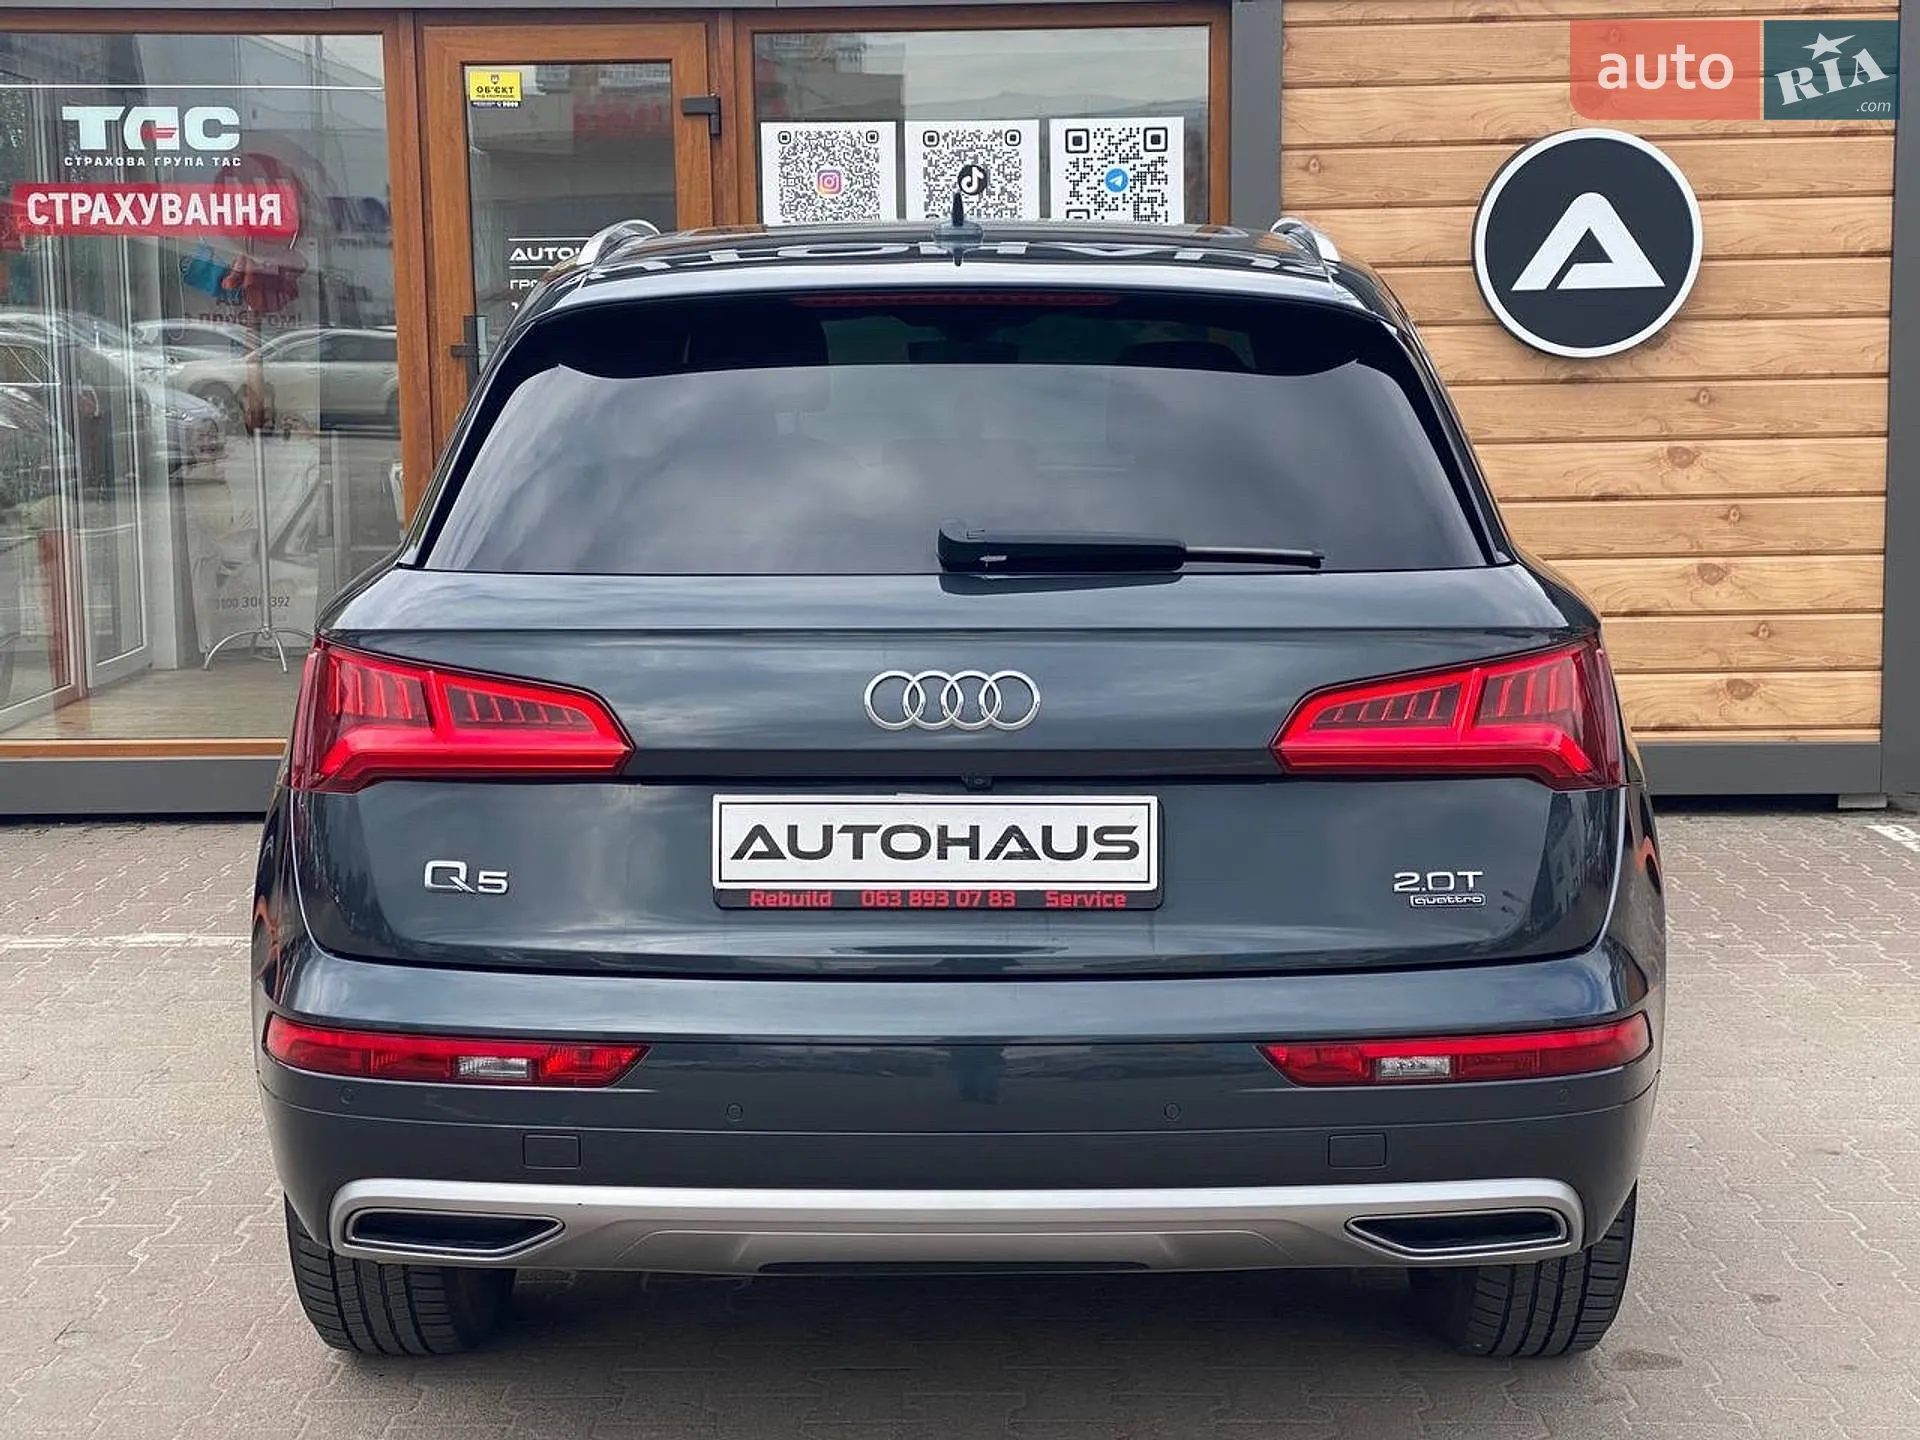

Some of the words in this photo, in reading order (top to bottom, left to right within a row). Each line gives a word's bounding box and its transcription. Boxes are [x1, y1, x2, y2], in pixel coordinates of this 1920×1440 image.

[64, 157, 146, 167] СТРАХОВА
[154, 157, 204, 167] ГРУПА
[212, 157, 241, 167] ТАС
[27, 192, 282, 226] СТРАХУВАННЯ
[509, 247, 581, 261] AUTO
[730, 823, 1140, 861] AUTOHAUS
[424, 860, 508, 894] Q5
[1393, 871, 1484, 892] 2.0T
[749, 890, 832, 907] Rebuild
[861, 890, 902, 907] 063
[908, 890, 949, 907] 893
[955, 890, 982, 907] 07
[988, 890, 1017, 907] 83
[1045, 890, 1127, 908] Service
[1413, 896, 1482, 906] quattro
